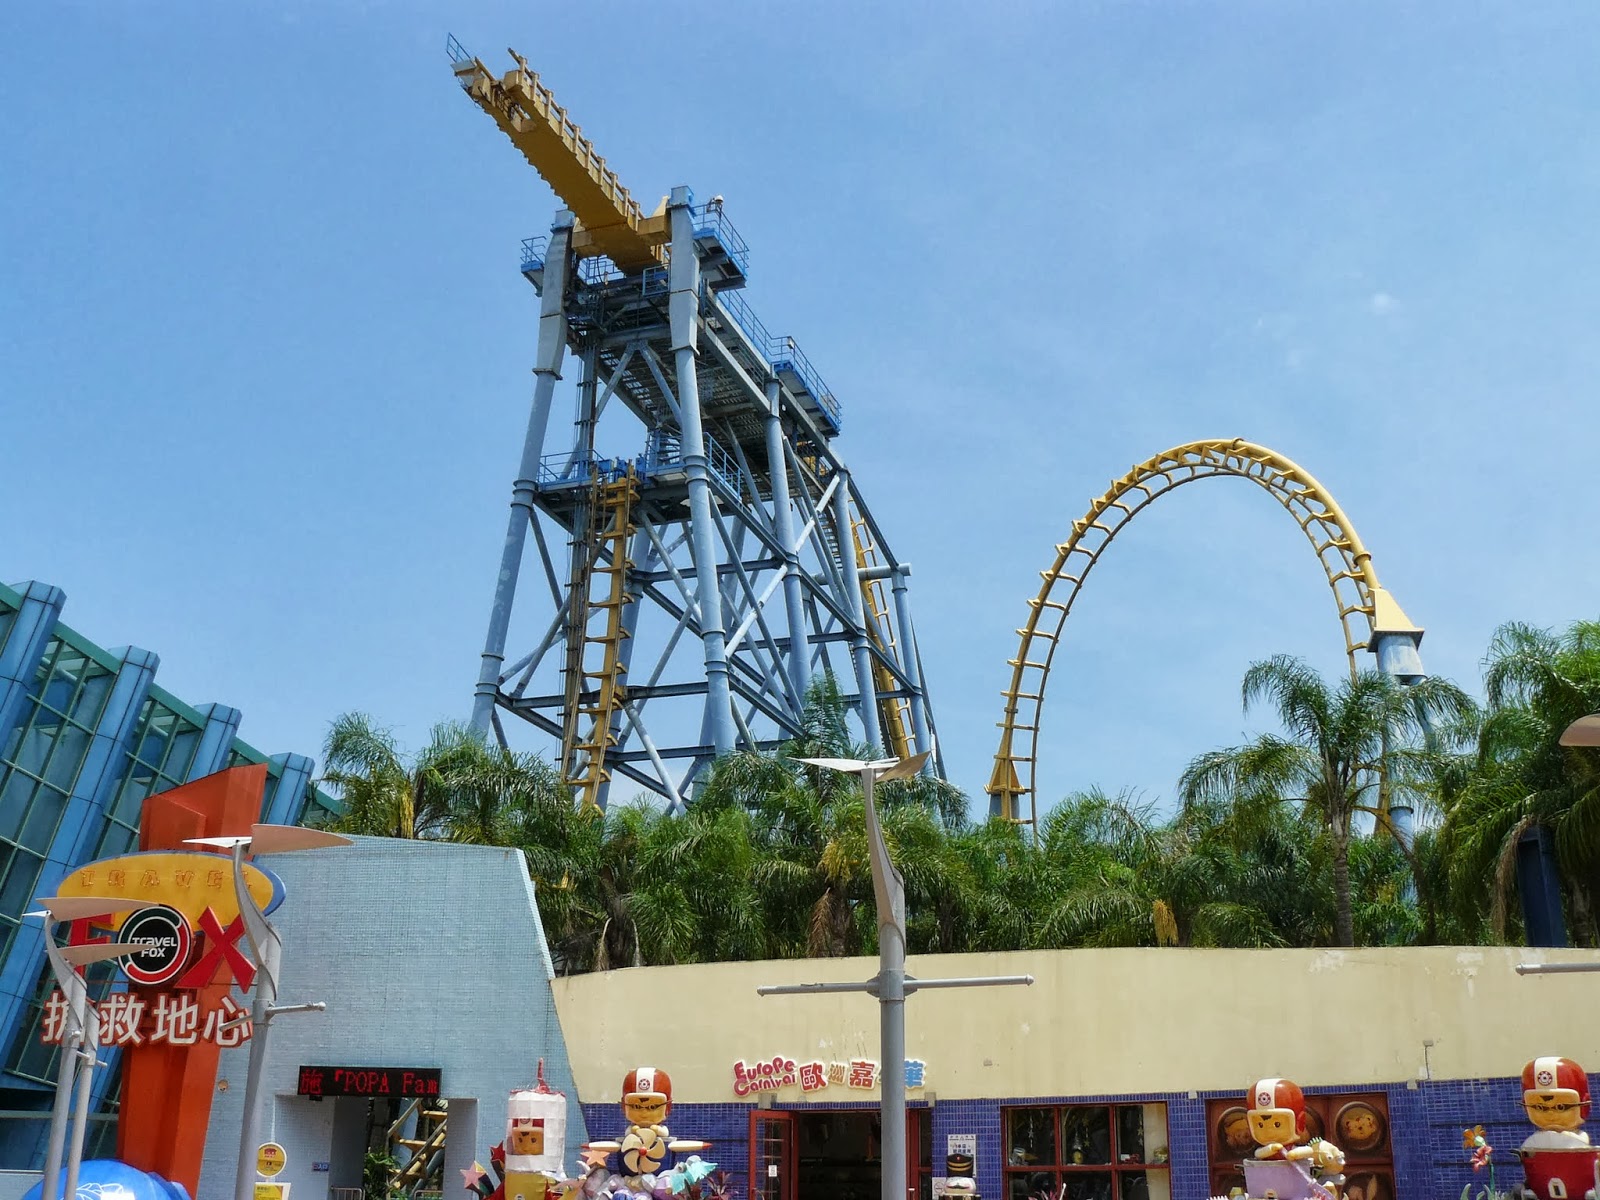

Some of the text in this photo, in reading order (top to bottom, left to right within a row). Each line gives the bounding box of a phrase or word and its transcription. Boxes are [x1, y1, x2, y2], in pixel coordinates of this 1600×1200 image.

[141, 947, 166, 957] FOX
[402, 1072, 440, 1094] Fam
[734, 1074, 796, 1096] Carnival
[799, 1060, 924, 1091] 歐洲嘉華
